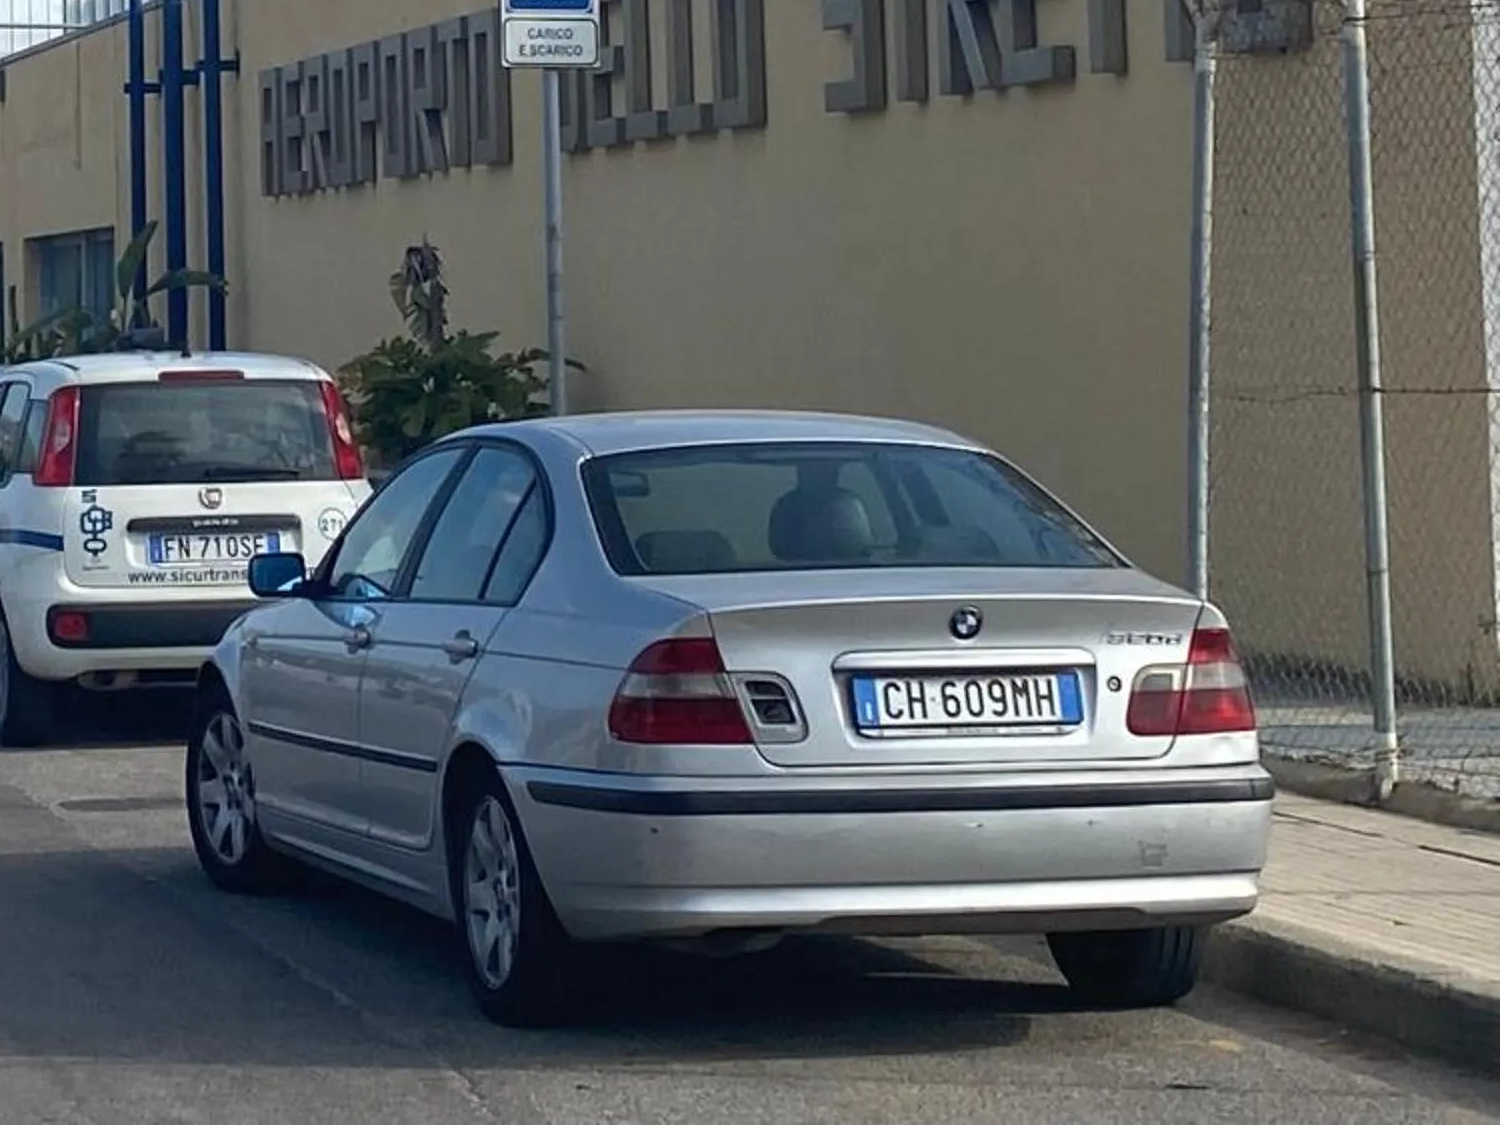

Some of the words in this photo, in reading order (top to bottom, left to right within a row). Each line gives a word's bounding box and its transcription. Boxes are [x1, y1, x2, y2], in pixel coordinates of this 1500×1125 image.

[527, 27, 573, 40] CARICO
[529, 44, 583, 57] SCARICO
[258, 6, 513, 197] AEROPORTO
[164, 536, 191, 559] FN
[128, 566, 249, 584] www.sicurtrans
[883, 680, 929, 720] CH
[941, 677, 1057, 718] 609MH
